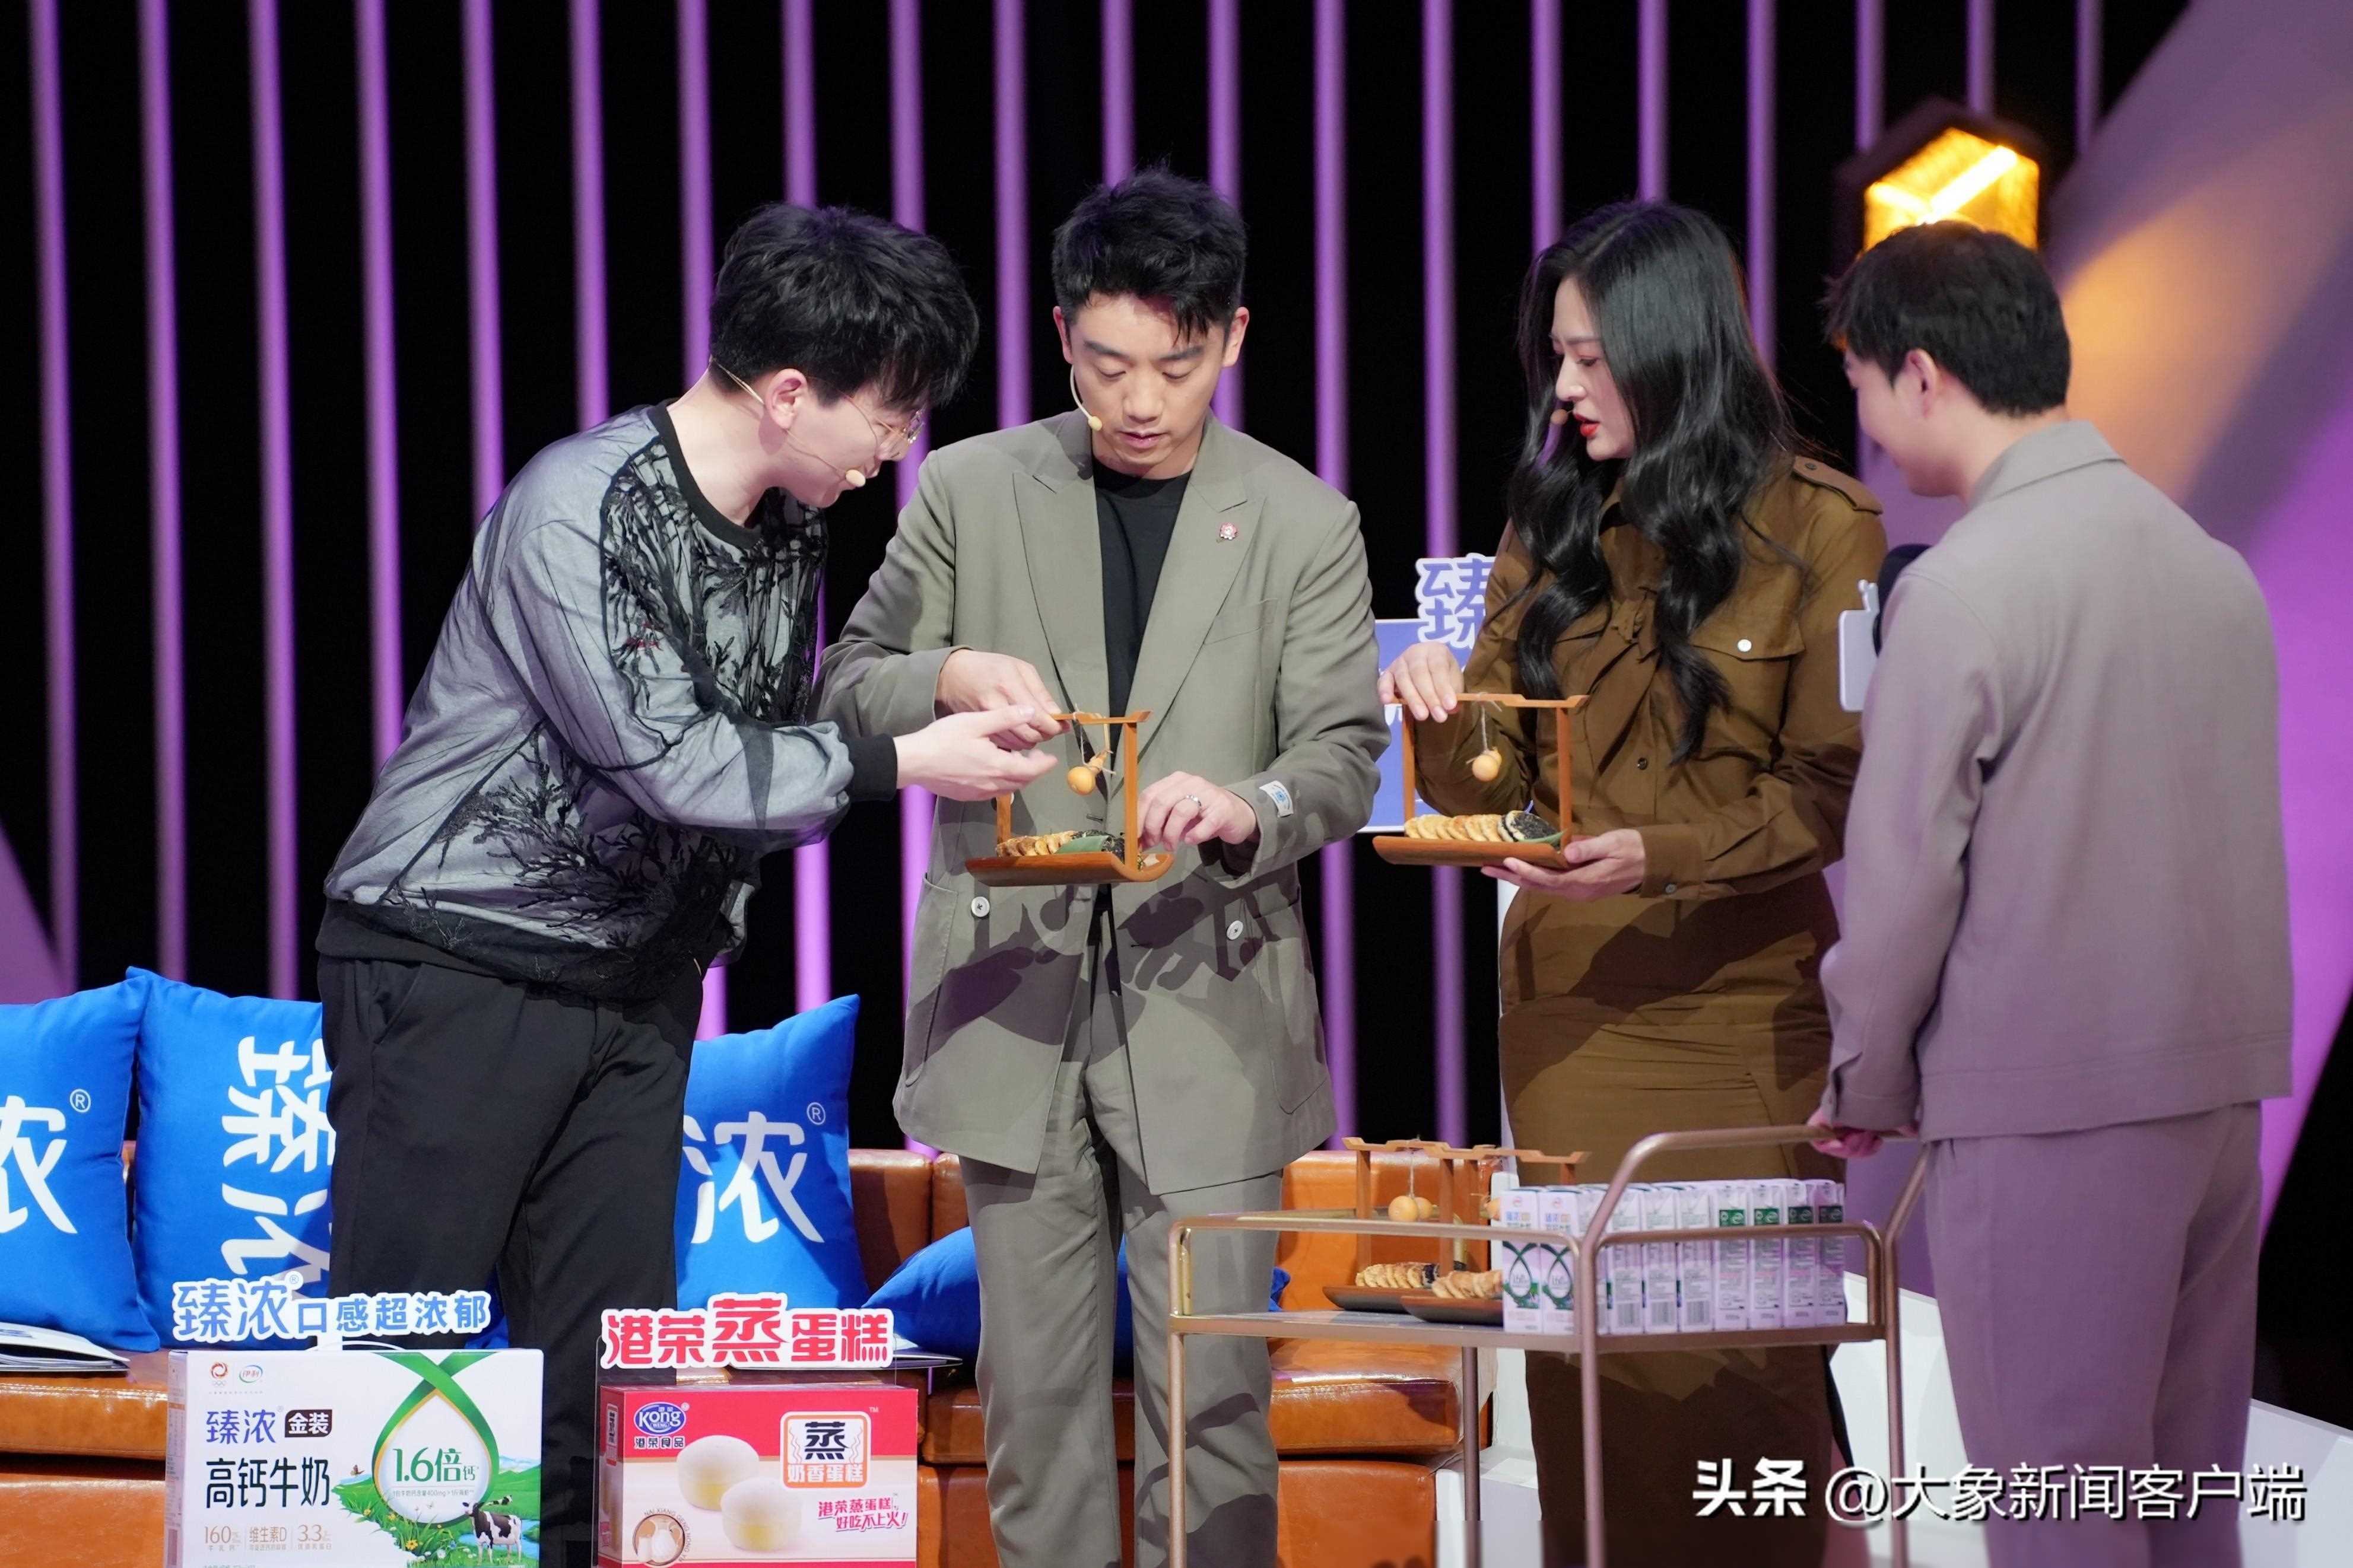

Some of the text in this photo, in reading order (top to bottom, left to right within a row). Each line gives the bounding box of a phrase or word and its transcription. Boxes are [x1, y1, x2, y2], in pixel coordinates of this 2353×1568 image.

[683, 1111, 825, 1243] 浓
[607, 1298, 888, 1364] 港荣蒸蛋糕
[206, 1409, 276, 1445] 臻浓
[288, 1412, 329, 1435] 金装
[639, 1411, 681, 1431] Kong
[804, 1421, 849, 1460] 蒸
[205, 1456, 329, 1510] 高钙牛奶
[787, 1464, 864, 1483] 奶香蛋糕
[818, 1497, 892, 1518] 港荣蒸蛋糕
[204, 1525, 231, 1544] 160
[249, 1526, 287, 1543] 维生素D
[297, 1524, 322, 1542] 3.3
